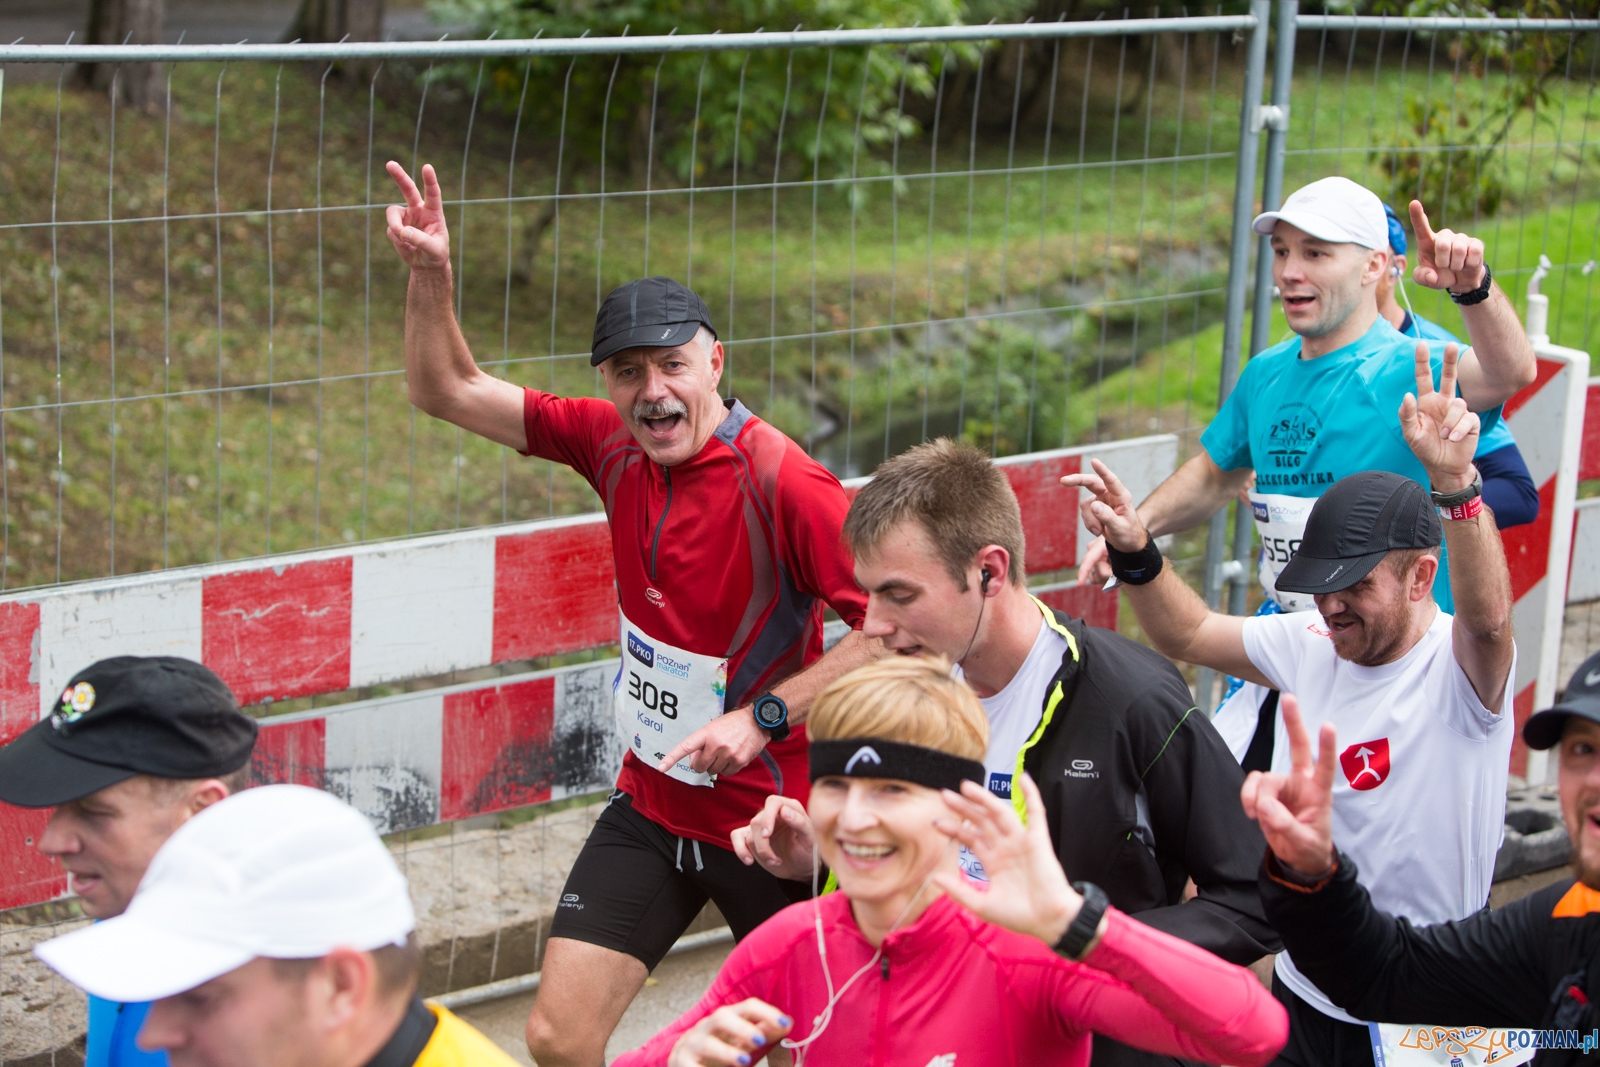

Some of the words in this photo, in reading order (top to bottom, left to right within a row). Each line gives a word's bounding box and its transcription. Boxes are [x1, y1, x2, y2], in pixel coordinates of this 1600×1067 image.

[1275, 456, 1300, 468] BIEG
[656, 661, 689, 679] maraton
[628, 669, 679, 721] 308
[637, 709, 664, 734] Karol
